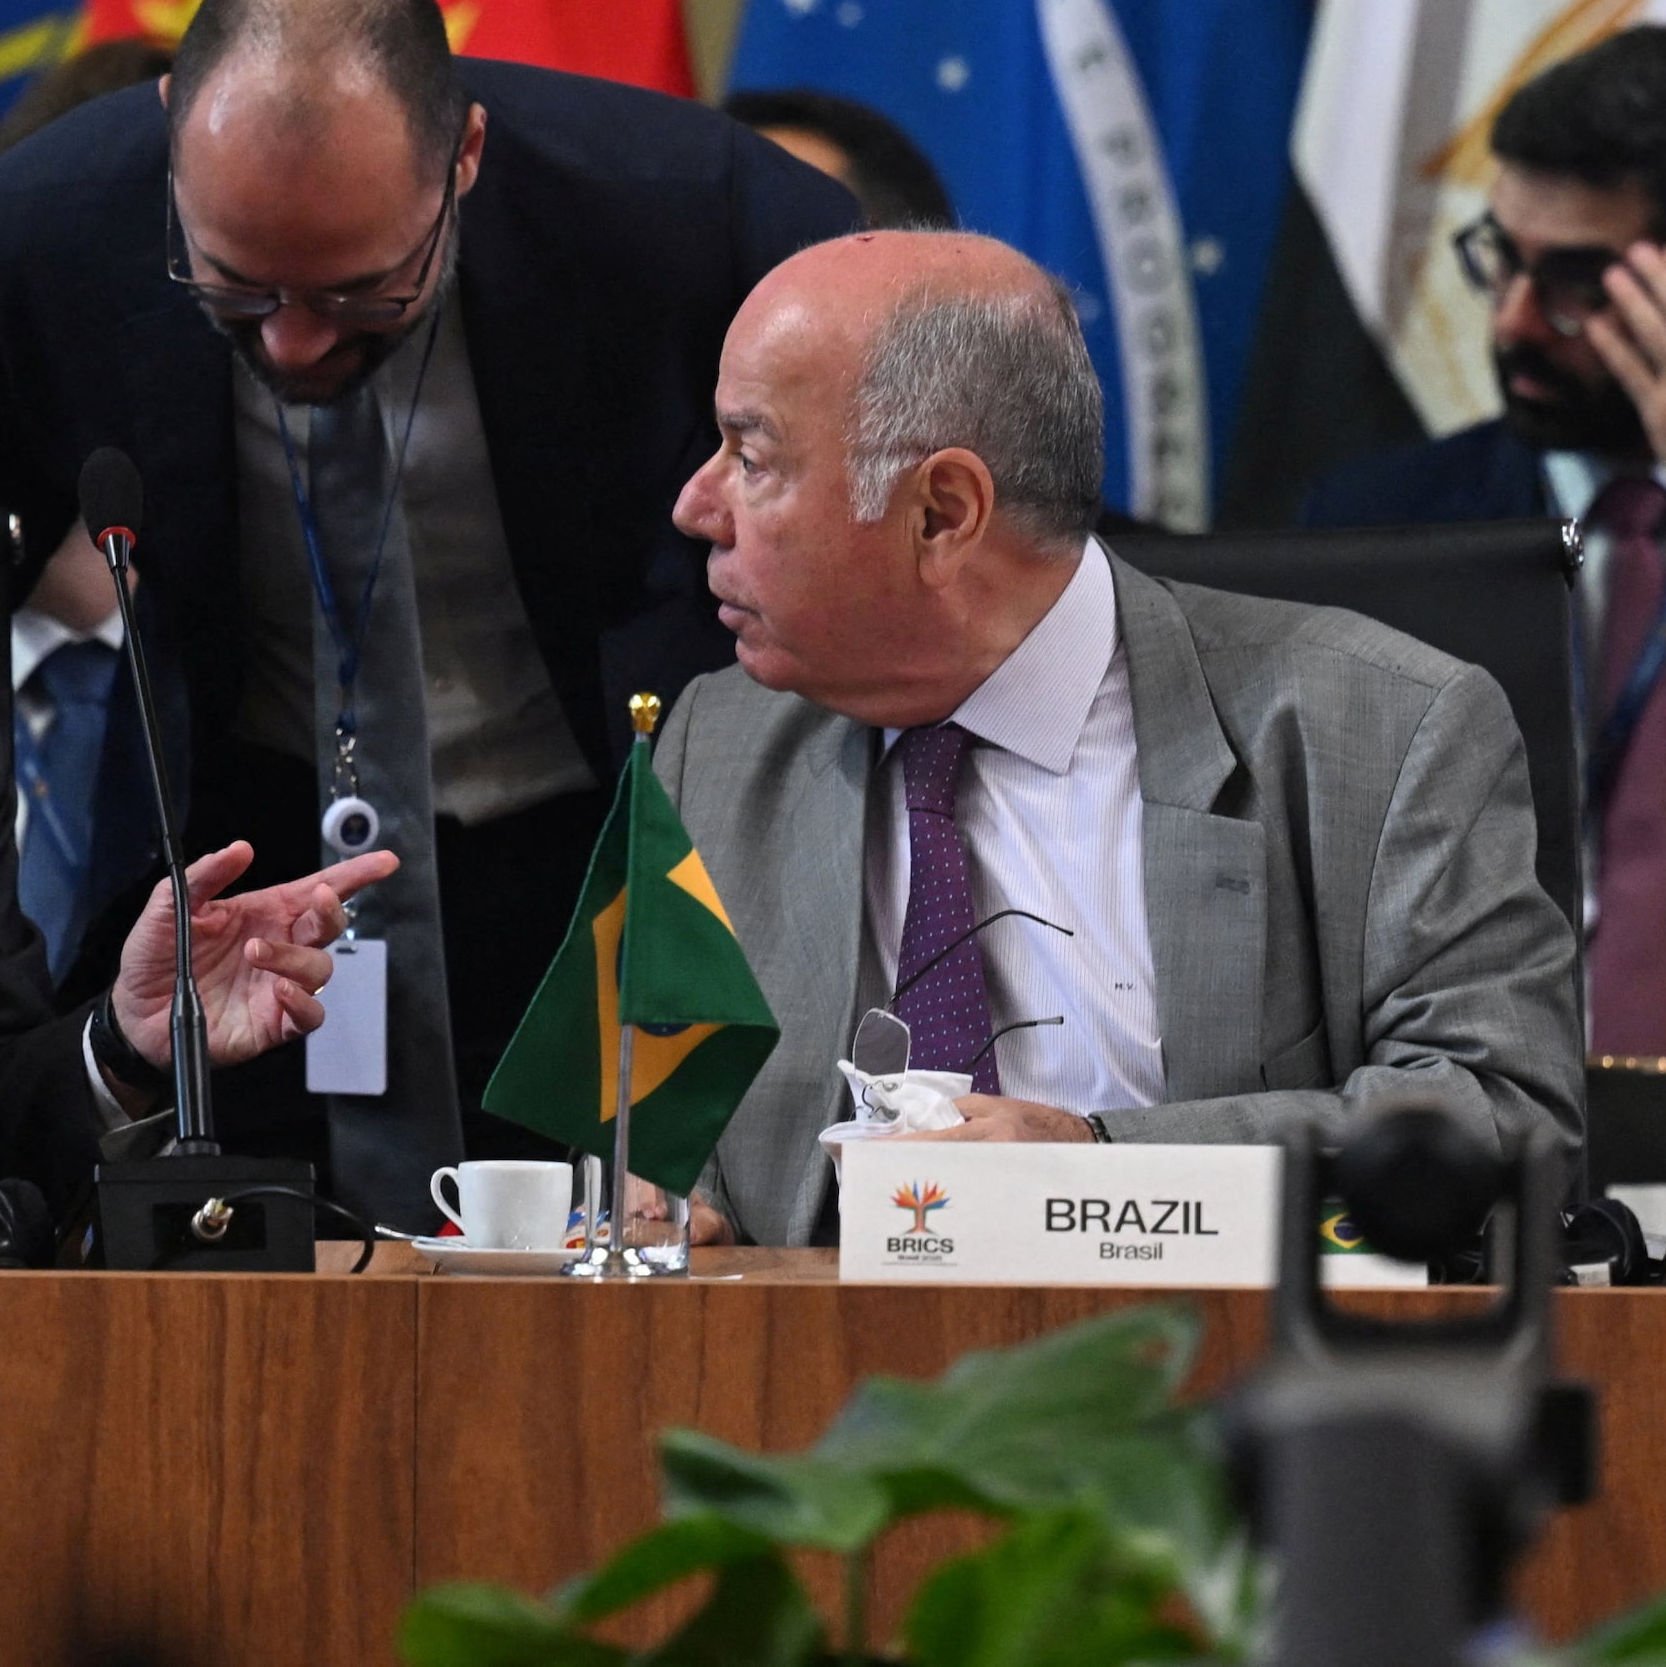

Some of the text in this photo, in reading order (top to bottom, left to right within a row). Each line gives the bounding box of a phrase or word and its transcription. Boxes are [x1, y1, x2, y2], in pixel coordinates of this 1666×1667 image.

[1045, 1198, 1219, 1235] BRAZIL
[887, 1237, 954, 1254] BRICS
[1099, 1242, 1164, 1261] Brasil
